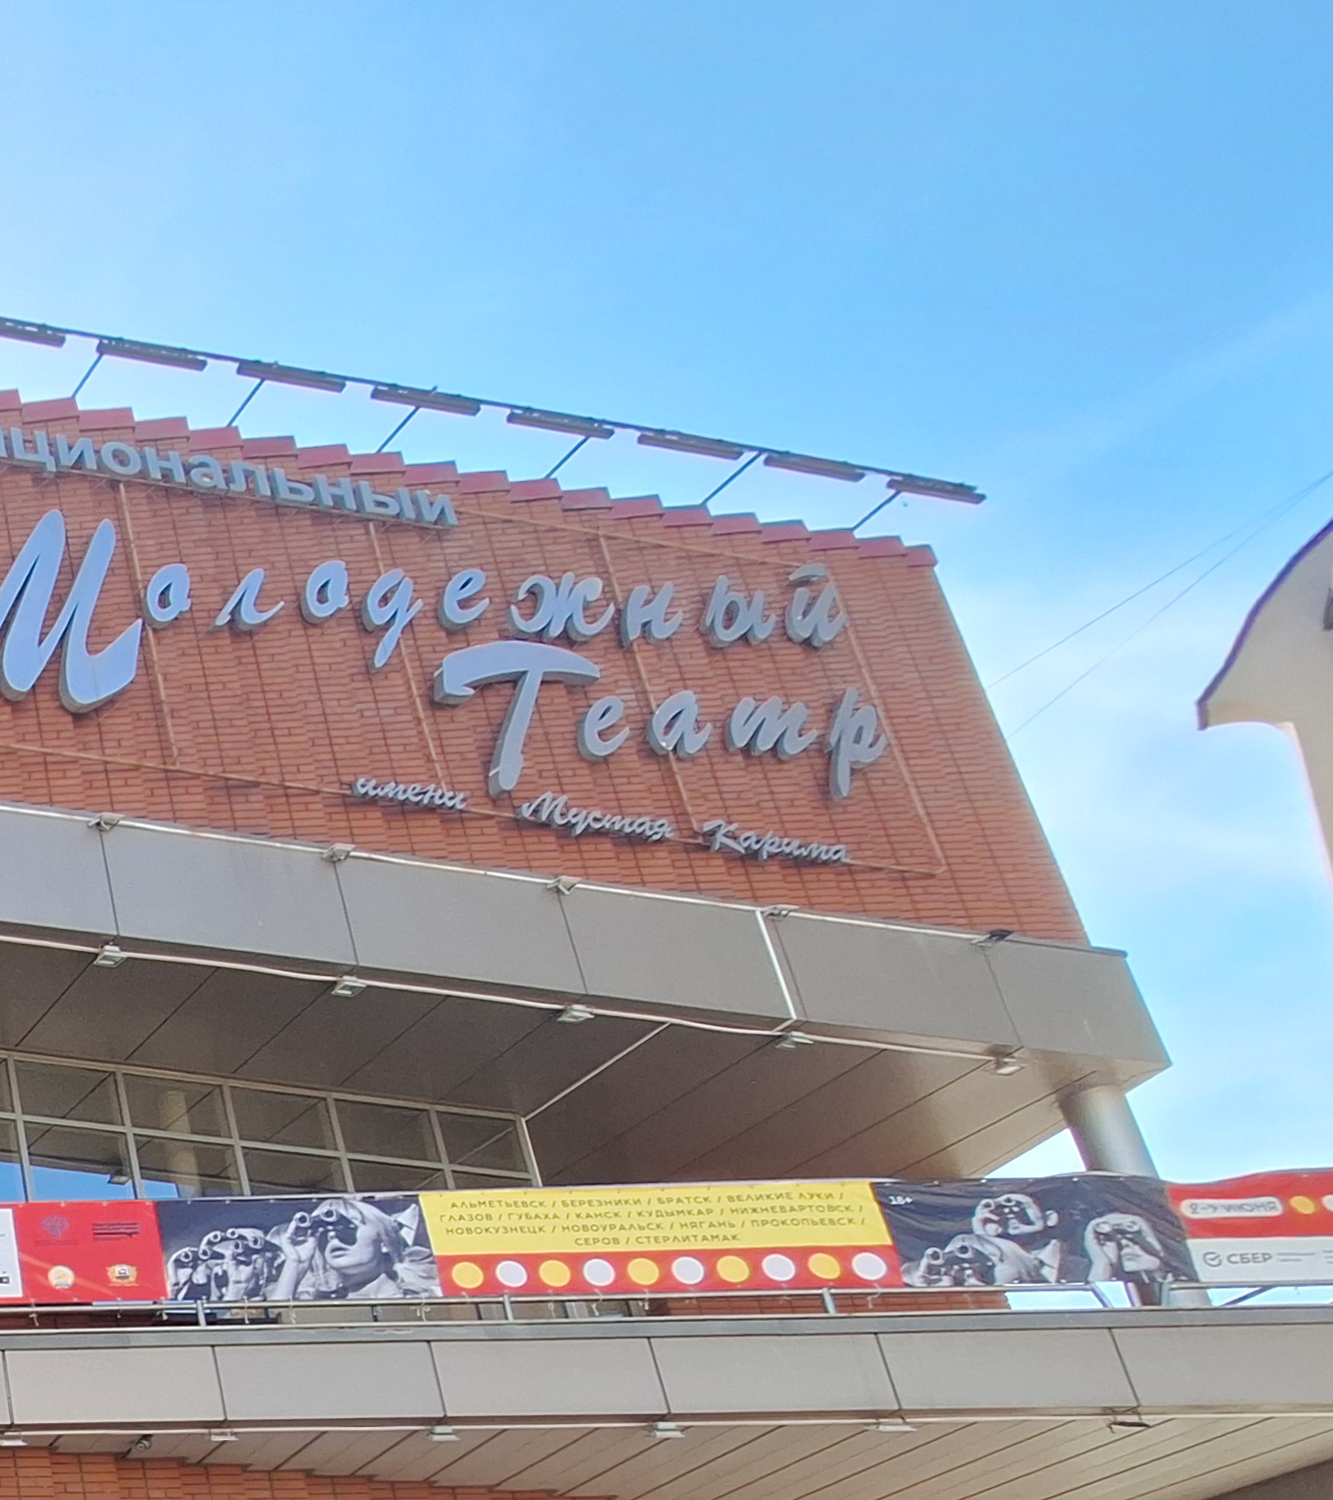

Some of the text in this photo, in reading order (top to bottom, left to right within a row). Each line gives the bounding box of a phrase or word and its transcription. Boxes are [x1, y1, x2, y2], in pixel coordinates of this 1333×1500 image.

[432, 641, 890, 799] Театр
[353, 776, 850, 864] имени Мустая Карима
[450, 1191, 834, 1209] АЛЬМЕТЬЕВСК БЕРЕЗНИКИ БРАТСК ВЕЛИКИЕ ЛУКИ
[439, 1205, 853, 1223] ГЛАЗОВ ГУБАХА КАНСК КУДЫМКАР НИЖНЕВАРТОВСК
[445, 1217, 856, 1236] НОВОКУЗНЕЦК НОВОУРАЛЬСК НЯГАНЬ ПРОКОПЬЕВСК
[574, 1234, 741, 1247] СЕРОВ СТЕРЛИТАМАК
[1226, 1252, 1273, 1265] СБЕР
